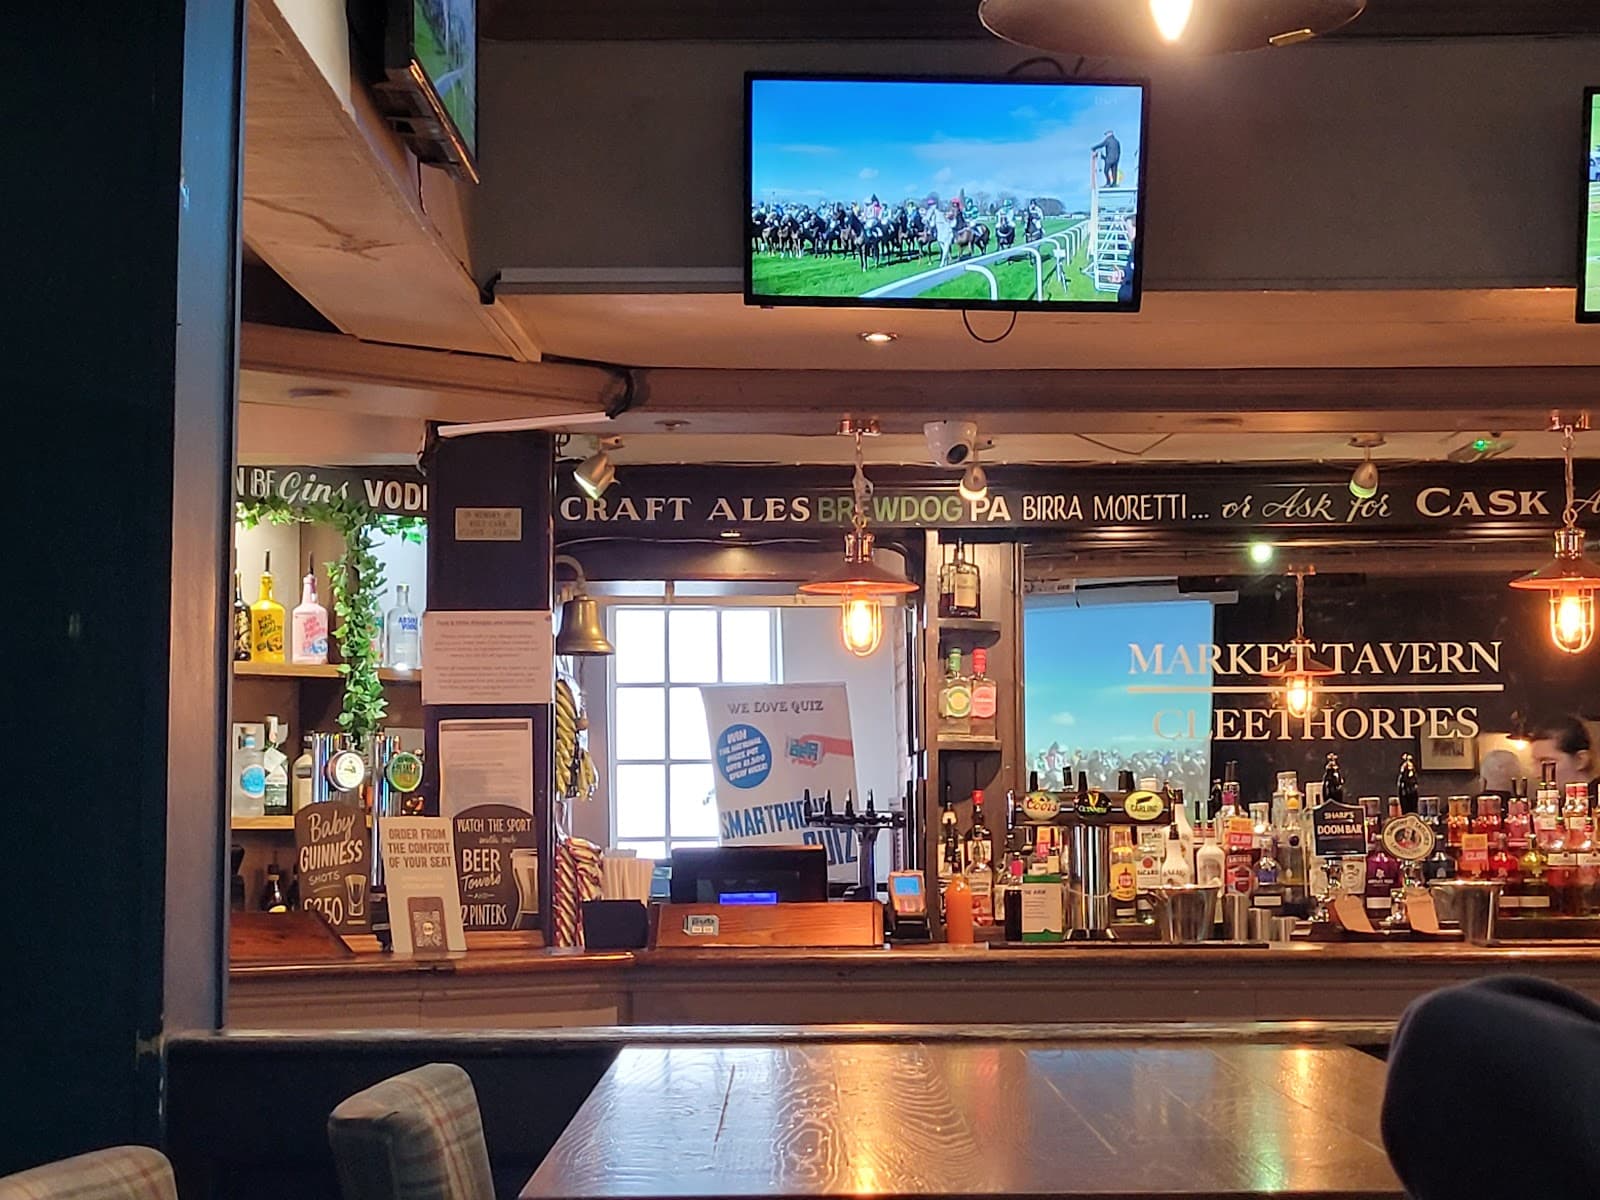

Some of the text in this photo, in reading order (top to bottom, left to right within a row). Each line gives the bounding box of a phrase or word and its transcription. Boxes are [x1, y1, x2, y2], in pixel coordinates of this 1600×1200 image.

[559, 496, 693, 522] CRAFT
[707, 496, 811, 522] ALES
[970, 496, 1011, 522] PA
[1022, 494, 1083, 521] BIRRA
[1221, 495, 1251, 519] or
[1262, 487, 1336, 521] Ask
[1346, 493, 1392, 522] for
[1416, 487, 1551, 517] CASK
[1127, 641, 1502, 675] MARKET TAVERN
[727, 700, 824, 714] WE LOVE QUIZ
[1152, 707, 1479, 740] CLEETHORPES
[307, 810, 356, 843] Baby
[457, 817, 532, 833] WATCH THE SPORT
[719, 797, 826, 840] SMARTPHO
[388, 828, 447, 841] ORDER FROM
[300, 840, 363, 872] GUINNESS
[387, 842, 451, 854] THE COMFORT
[462, 848, 502, 873] BEER
[389, 856, 452, 869] OF YOUR SEAT
[308, 871, 341, 886] SHOTS
